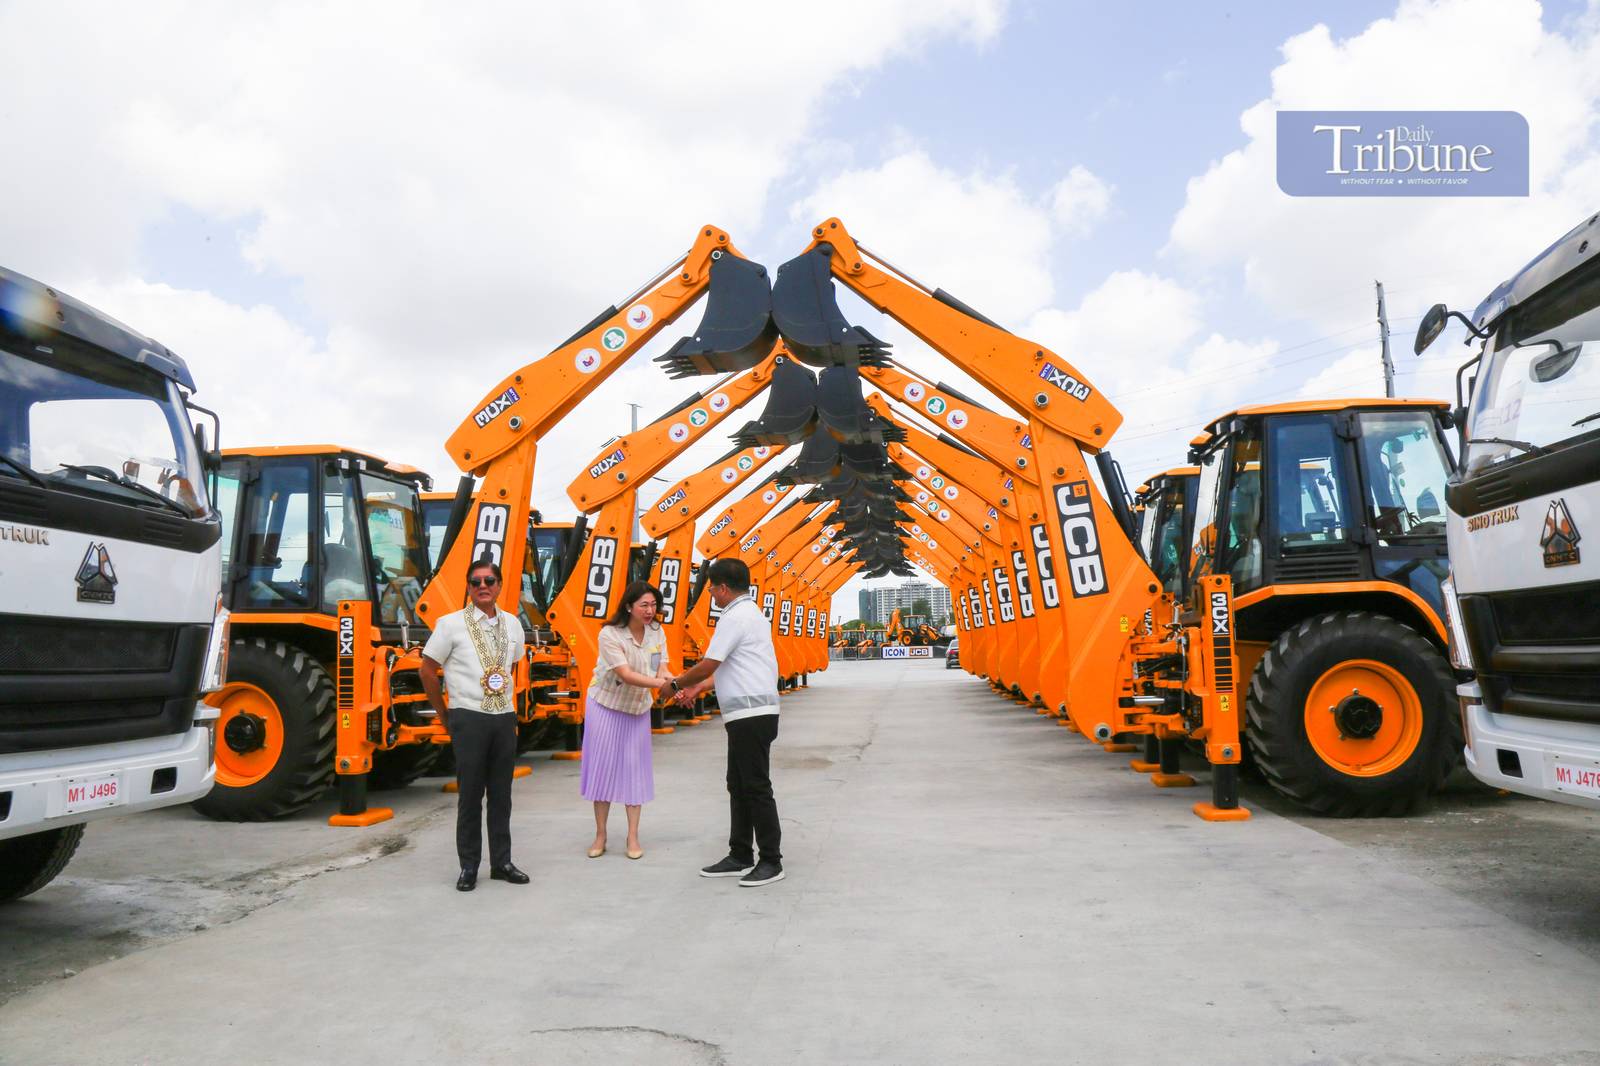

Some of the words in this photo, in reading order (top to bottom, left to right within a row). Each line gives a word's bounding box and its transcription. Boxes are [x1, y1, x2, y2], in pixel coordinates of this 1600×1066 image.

[1048, 368, 1091, 401] 3CX
[474, 393, 512, 427] 3CX
[1467, 505, 1520, 532] SINOTRUK
[473, 506, 507, 567] CB
[1057, 486, 1105, 595] JCB
[587, 539, 616, 617] JCB
[659, 560, 680, 624] JCB
[994, 569, 1015, 621] JCB
[763, 594, 775, 621] CB
[780, 600, 792, 636] JCB
[794, 605, 804, 636] JCB
[807, 609, 817, 638] JCB
[969, 588, 984, 627] JCB
[1211, 593, 1229, 633] 3CX
[340, 617, 354, 654] 3CX
[819, 612, 827, 639] JCB
[885, 648, 905, 657] ICON
[68, 787, 85, 802] M1
[89, 782, 117, 799] J496
[1556, 768, 1571, 784] M1
